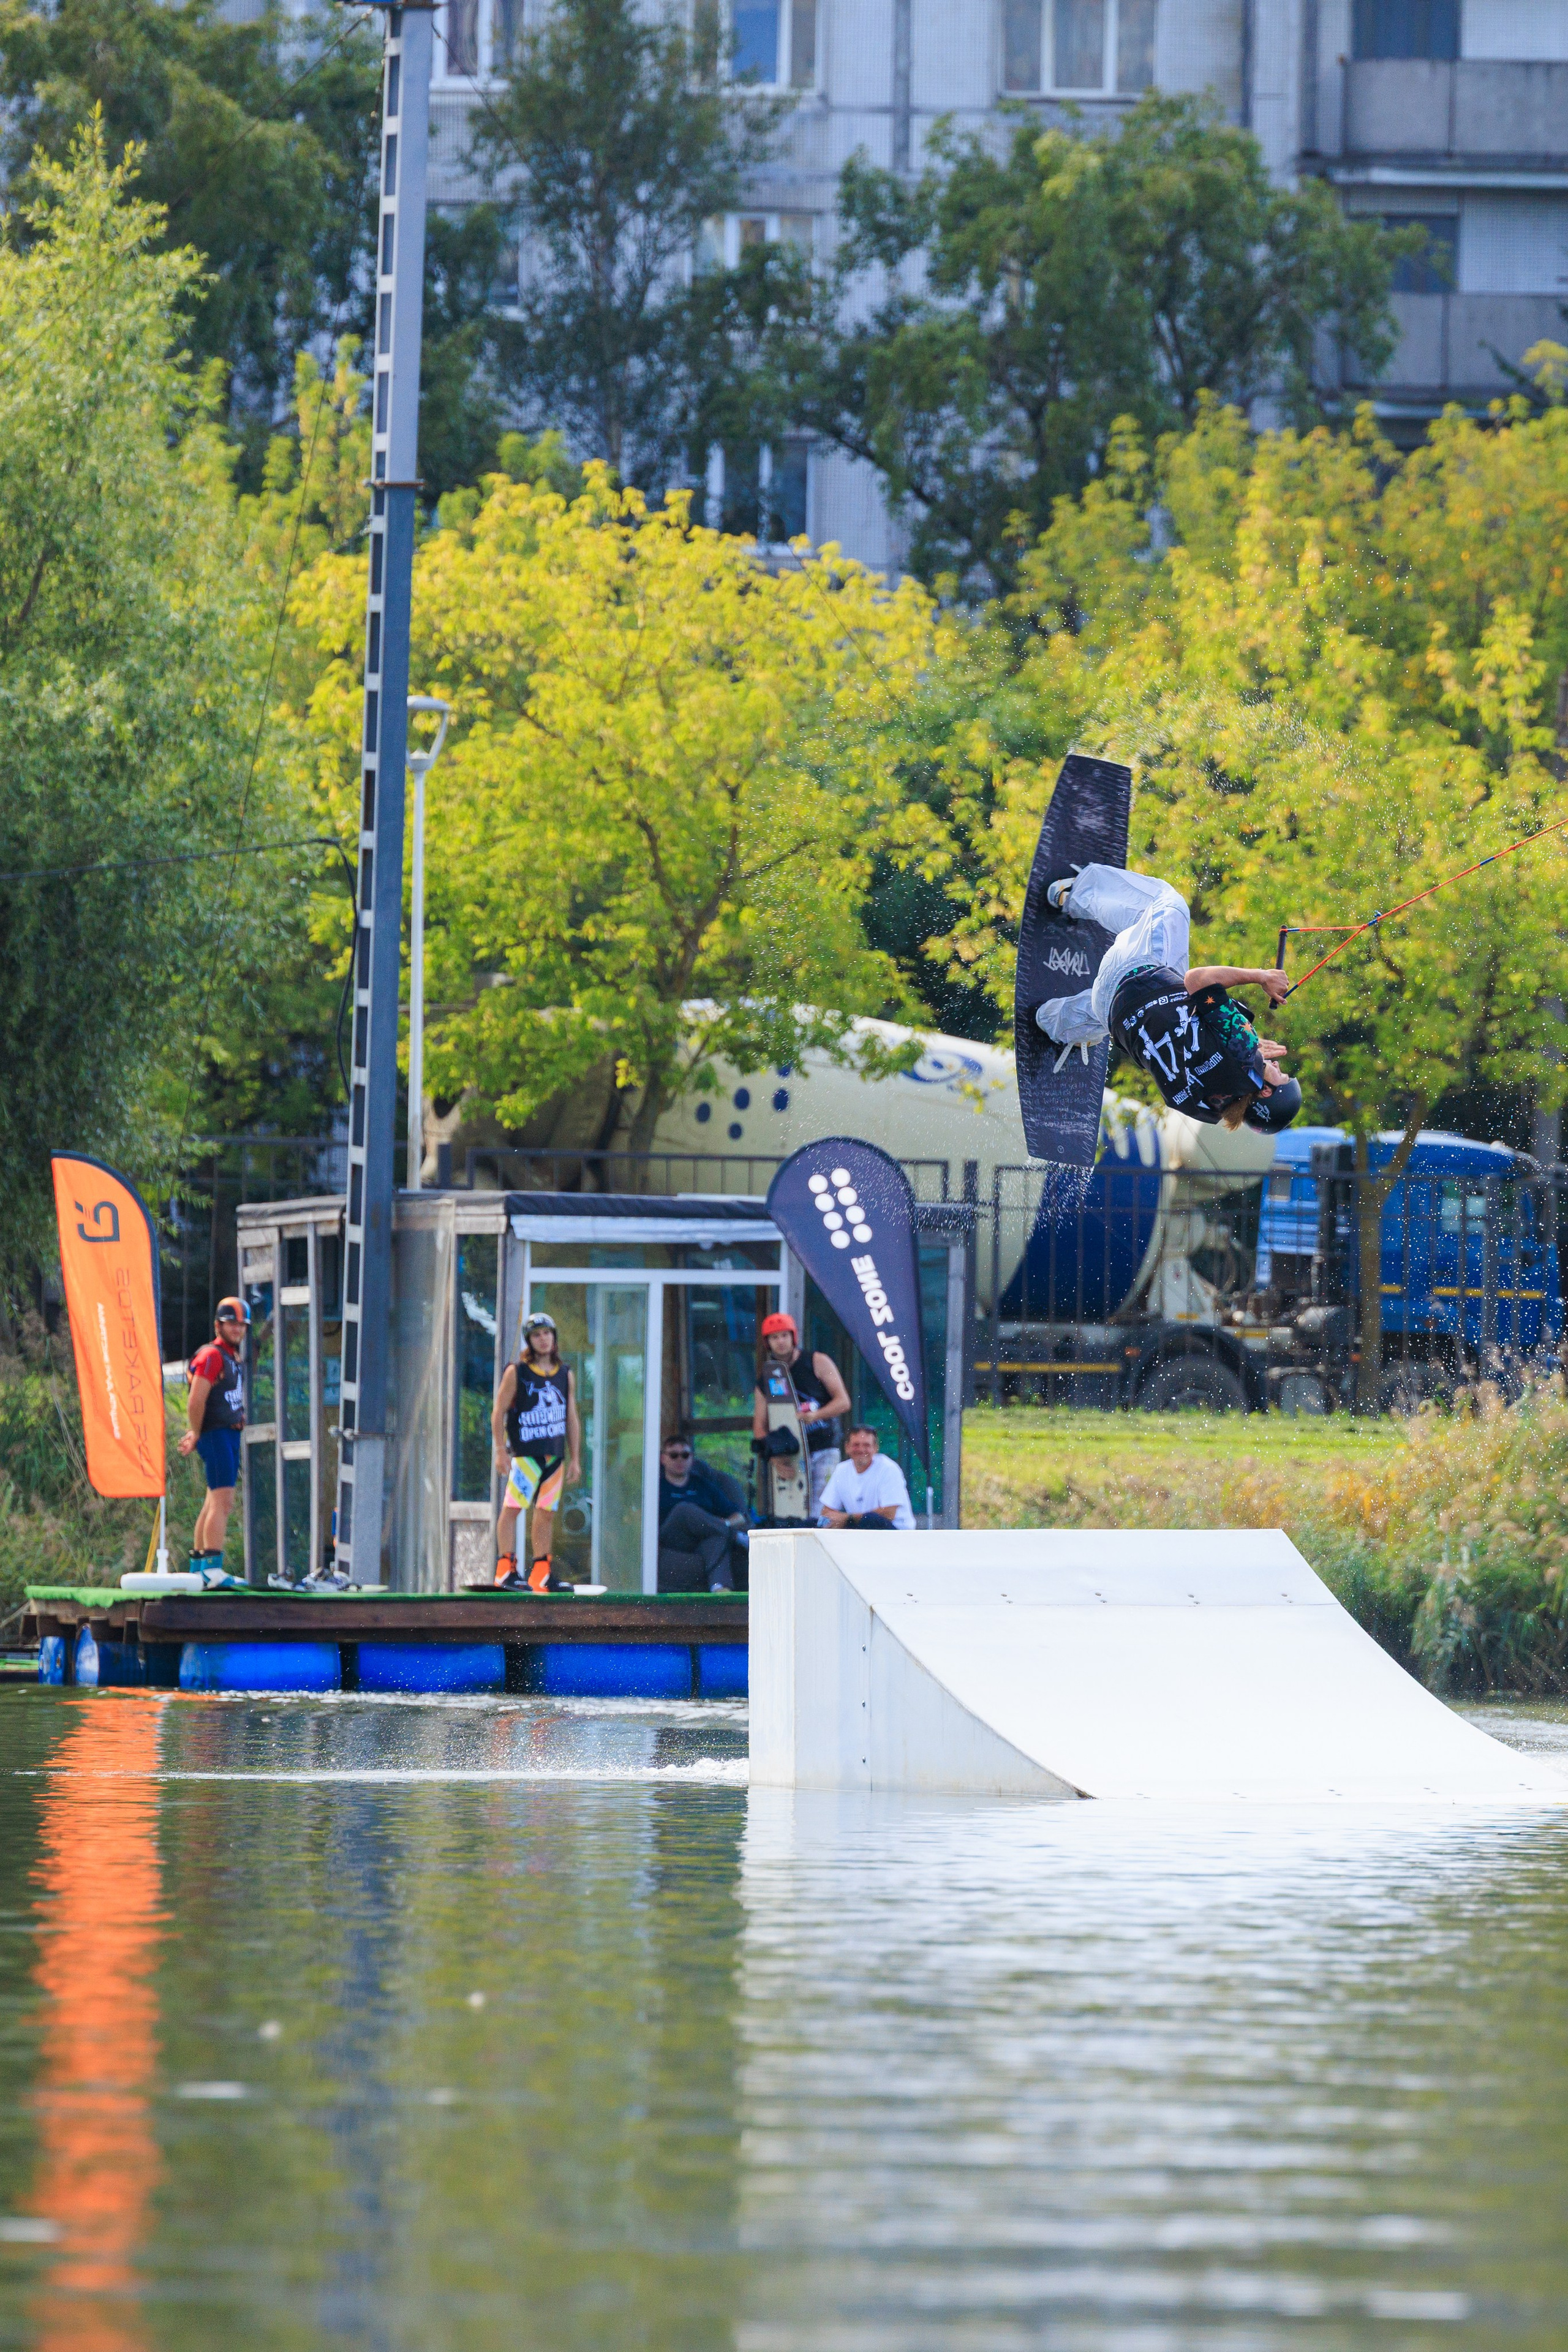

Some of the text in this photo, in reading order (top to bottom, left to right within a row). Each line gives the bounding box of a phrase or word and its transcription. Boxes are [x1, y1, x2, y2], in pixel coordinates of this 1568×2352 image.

[1172, 1052, 1224, 1105] KUPCHINO PARK
[521, 1426, 547, 1441] OPEN
